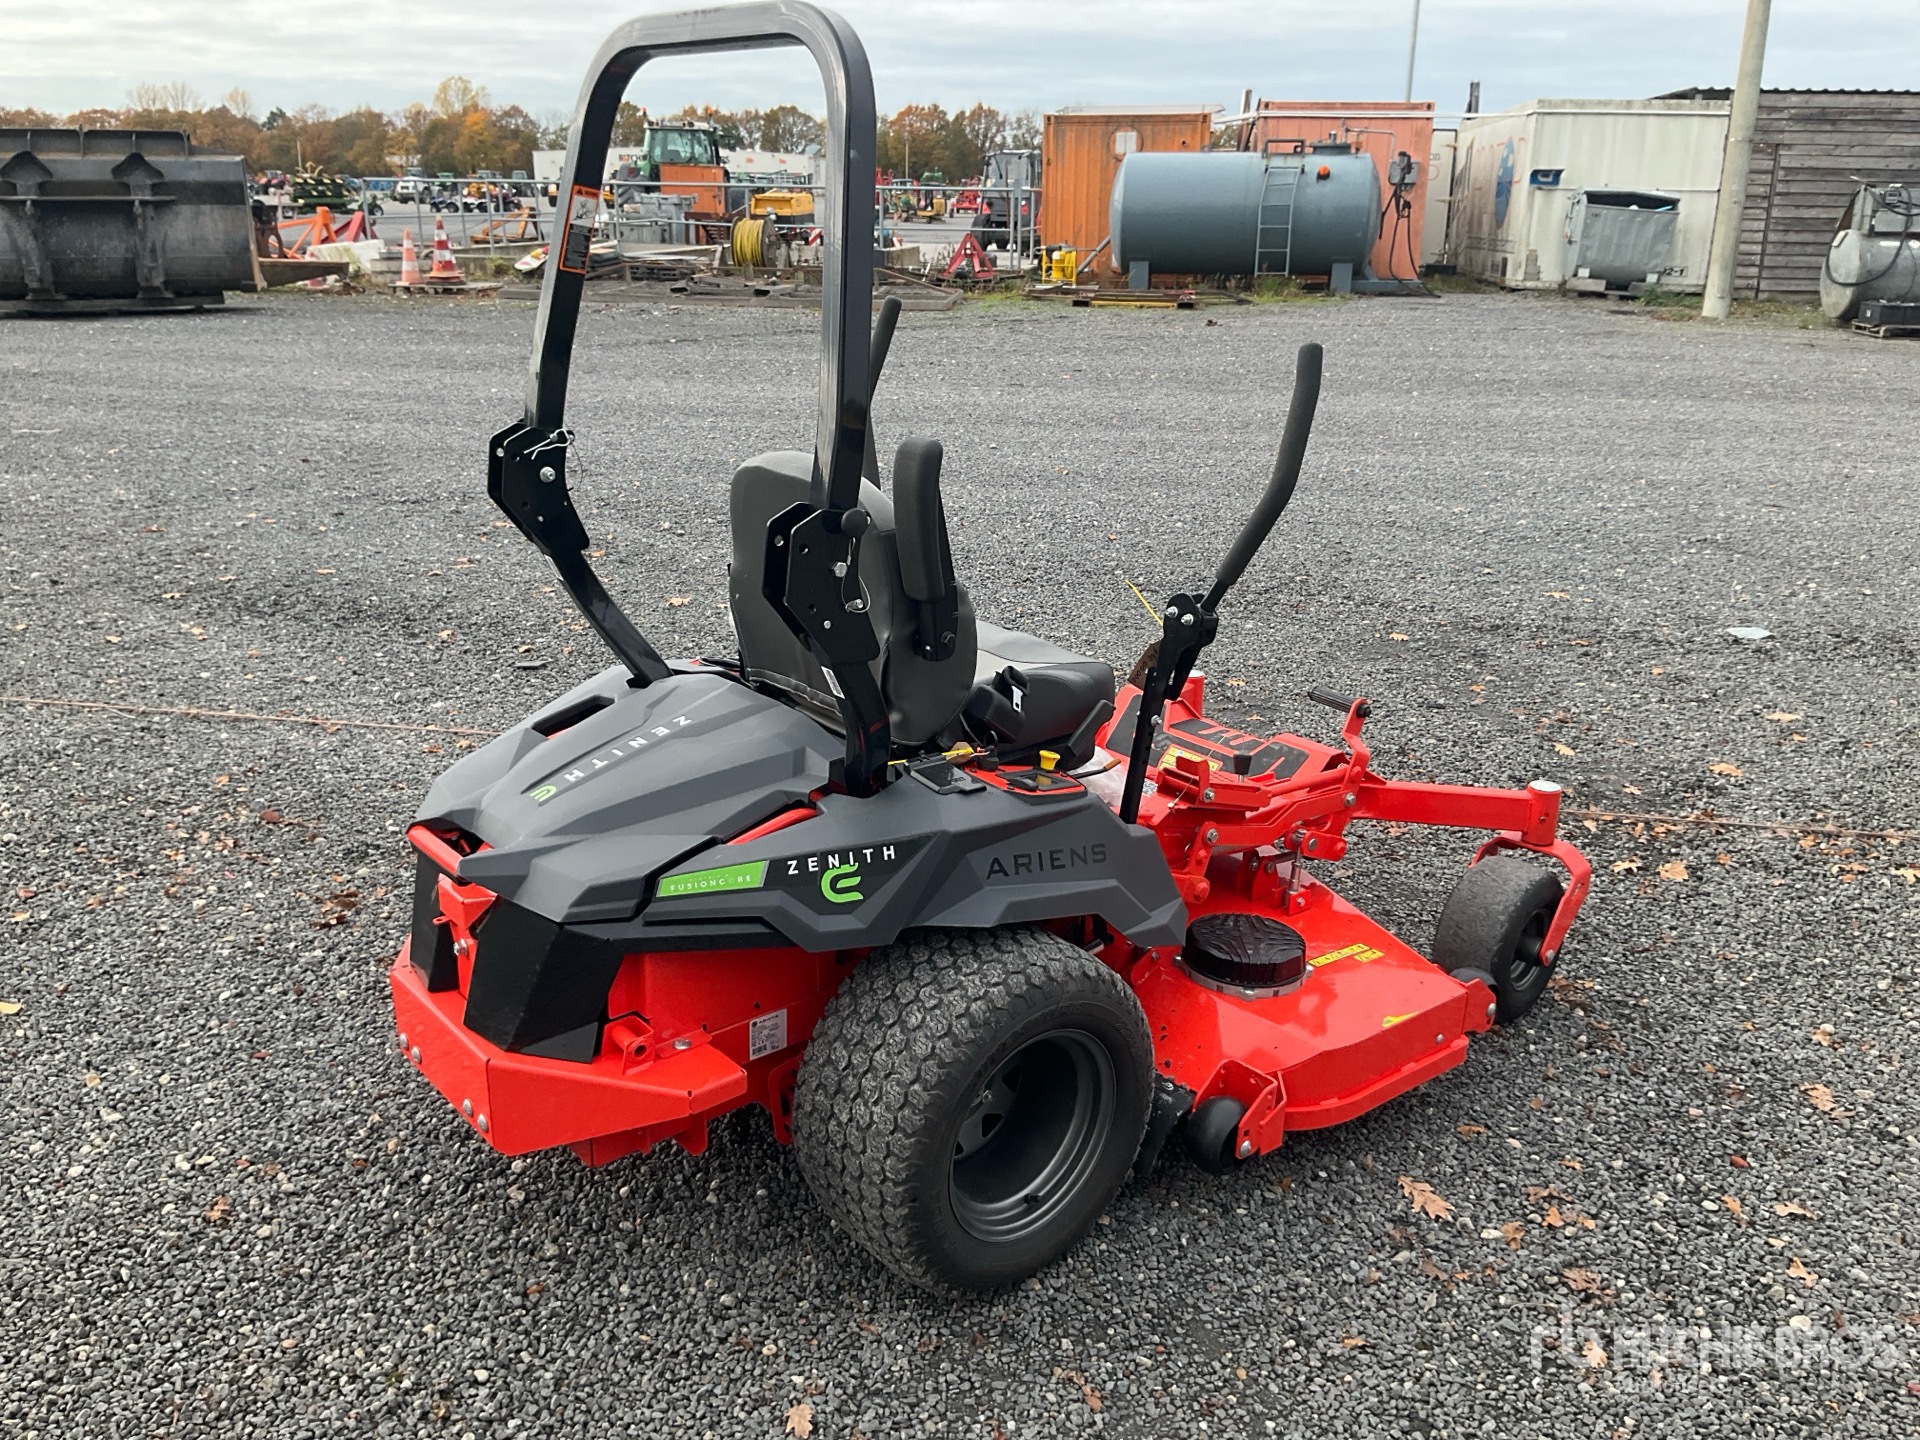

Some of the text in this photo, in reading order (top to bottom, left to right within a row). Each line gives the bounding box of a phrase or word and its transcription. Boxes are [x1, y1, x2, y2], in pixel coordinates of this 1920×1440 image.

[563, 715, 692, 782] ZENITH
[787, 845, 896, 876] ZENITH
[985, 842, 1107, 880] ARIENS
